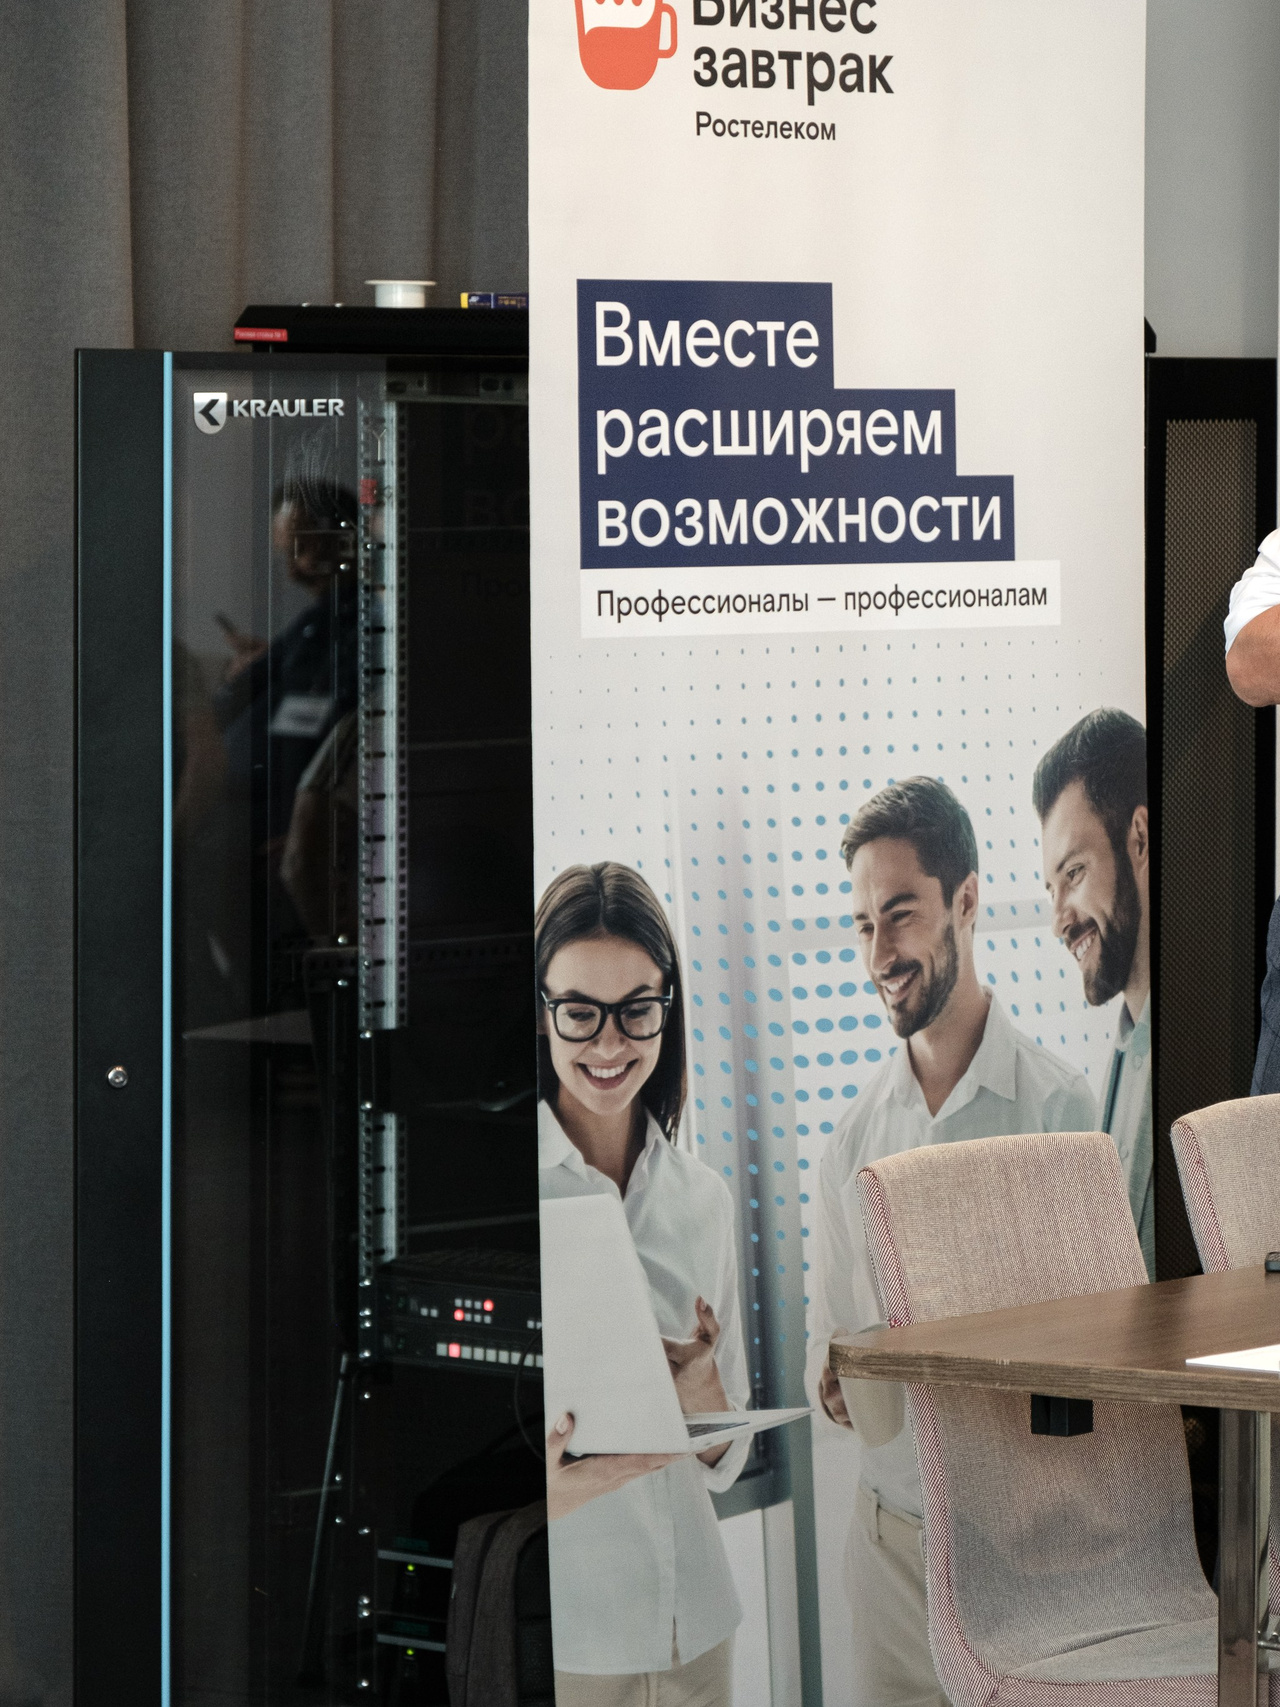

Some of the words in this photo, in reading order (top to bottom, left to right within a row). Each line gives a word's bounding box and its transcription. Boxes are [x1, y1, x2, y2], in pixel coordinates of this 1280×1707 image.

[693, 46, 895, 107] завтрак
[695, 111, 837, 141] Ростелеком
[595, 301, 820, 369] Вместе
[232, 398, 346, 418] KRAULER
[596, 408, 943, 475] расширяем
[597, 495, 1001, 548] возможности
[597, 588, 809, 624] Профессионалы
[844, 583, 1048, 618] профессионалам
